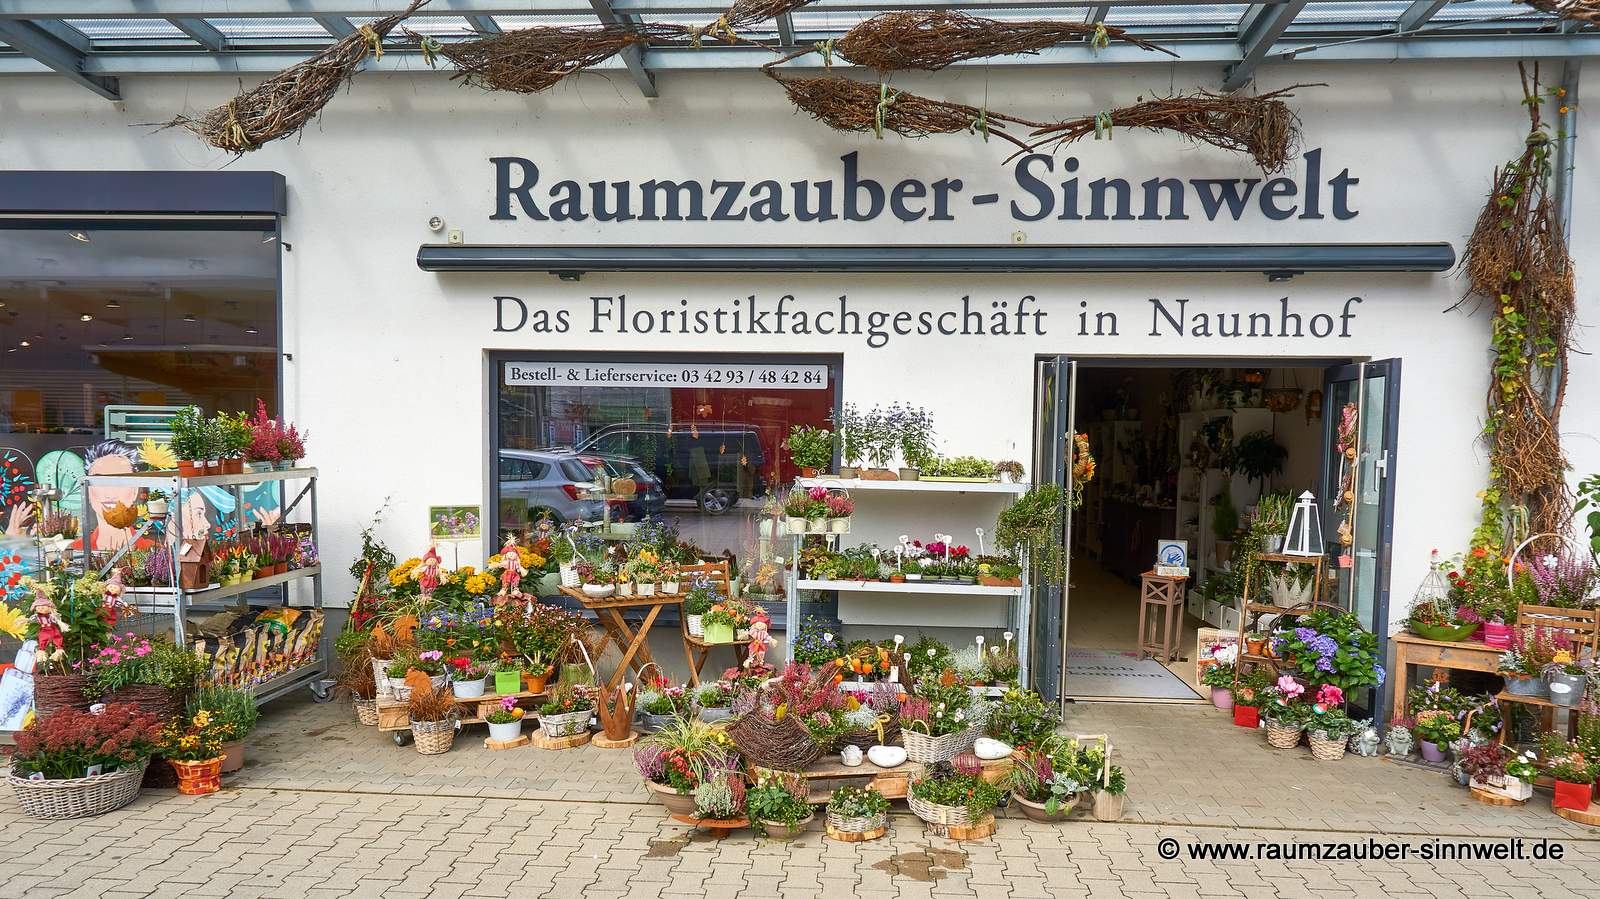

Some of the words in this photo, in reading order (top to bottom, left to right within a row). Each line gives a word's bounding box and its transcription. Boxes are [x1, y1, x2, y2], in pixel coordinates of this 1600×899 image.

[489, 149, 1360, 222] Raumzauber-Sinnwelt
[492, 296, 571, 333] Das
[589, 294, 1048, 348] Floristikfachgeschäft
[1077, 301, 1120, 336] in
[1148, 296, 1363, 338] Naunhof
[511, 367, 562, 381] Bestell-
[567, 368, 580, 381] &
[585, 367, 677, 383] Lieferservice:
[681, 369, 700, 384] 03
[703, 368, 722, 384] 42
[726, 370, 745, 384] 93
[748, 369, 754, 384] /
[758, 369, 777, 384] 48
[781, 369, 799, 384] 42
[803, 370, 822, 384] 84
